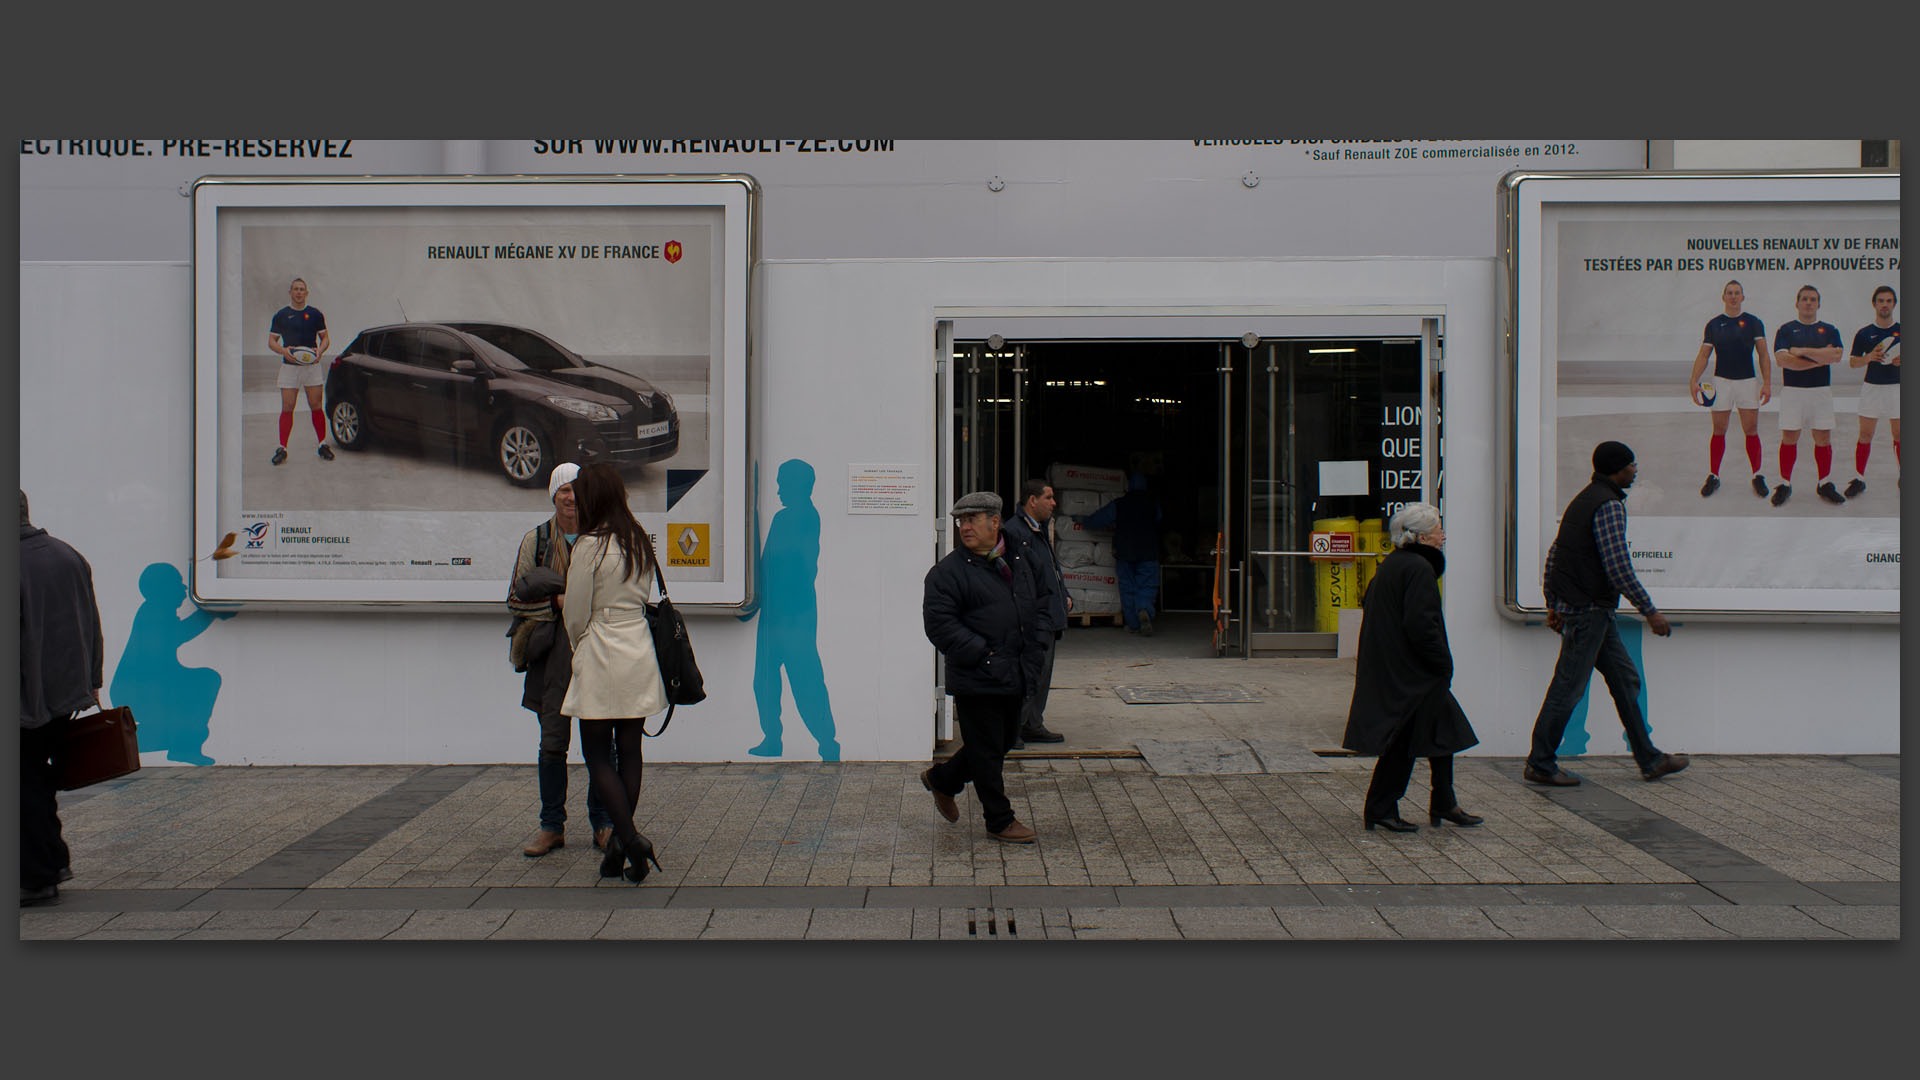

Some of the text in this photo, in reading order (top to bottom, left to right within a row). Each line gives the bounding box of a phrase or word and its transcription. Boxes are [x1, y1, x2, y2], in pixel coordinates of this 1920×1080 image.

[533, 140, 583, 154] SUR
[1312, 143, 1579, 161] Sauf Renault ZOE commercialisée en 2012.
[428, 242, 660, 259] RENAULT MÉGANE XV DE FRANCE
[1687, 238, 1900, 250] NOUVELLES RENAULT XV DE FRAN
[1583, 255, 1642, 271] TESTÉES
[1646, 258, 1673, 271] PAR
[1677, 258, 1705, 271] DES
[1708, 258, 1790, 271] RUGBYMEN.
[1793, 254, 1885, 271] APPROUVÉES
[1631, 551, 1672, 559] OFFICIELLE
